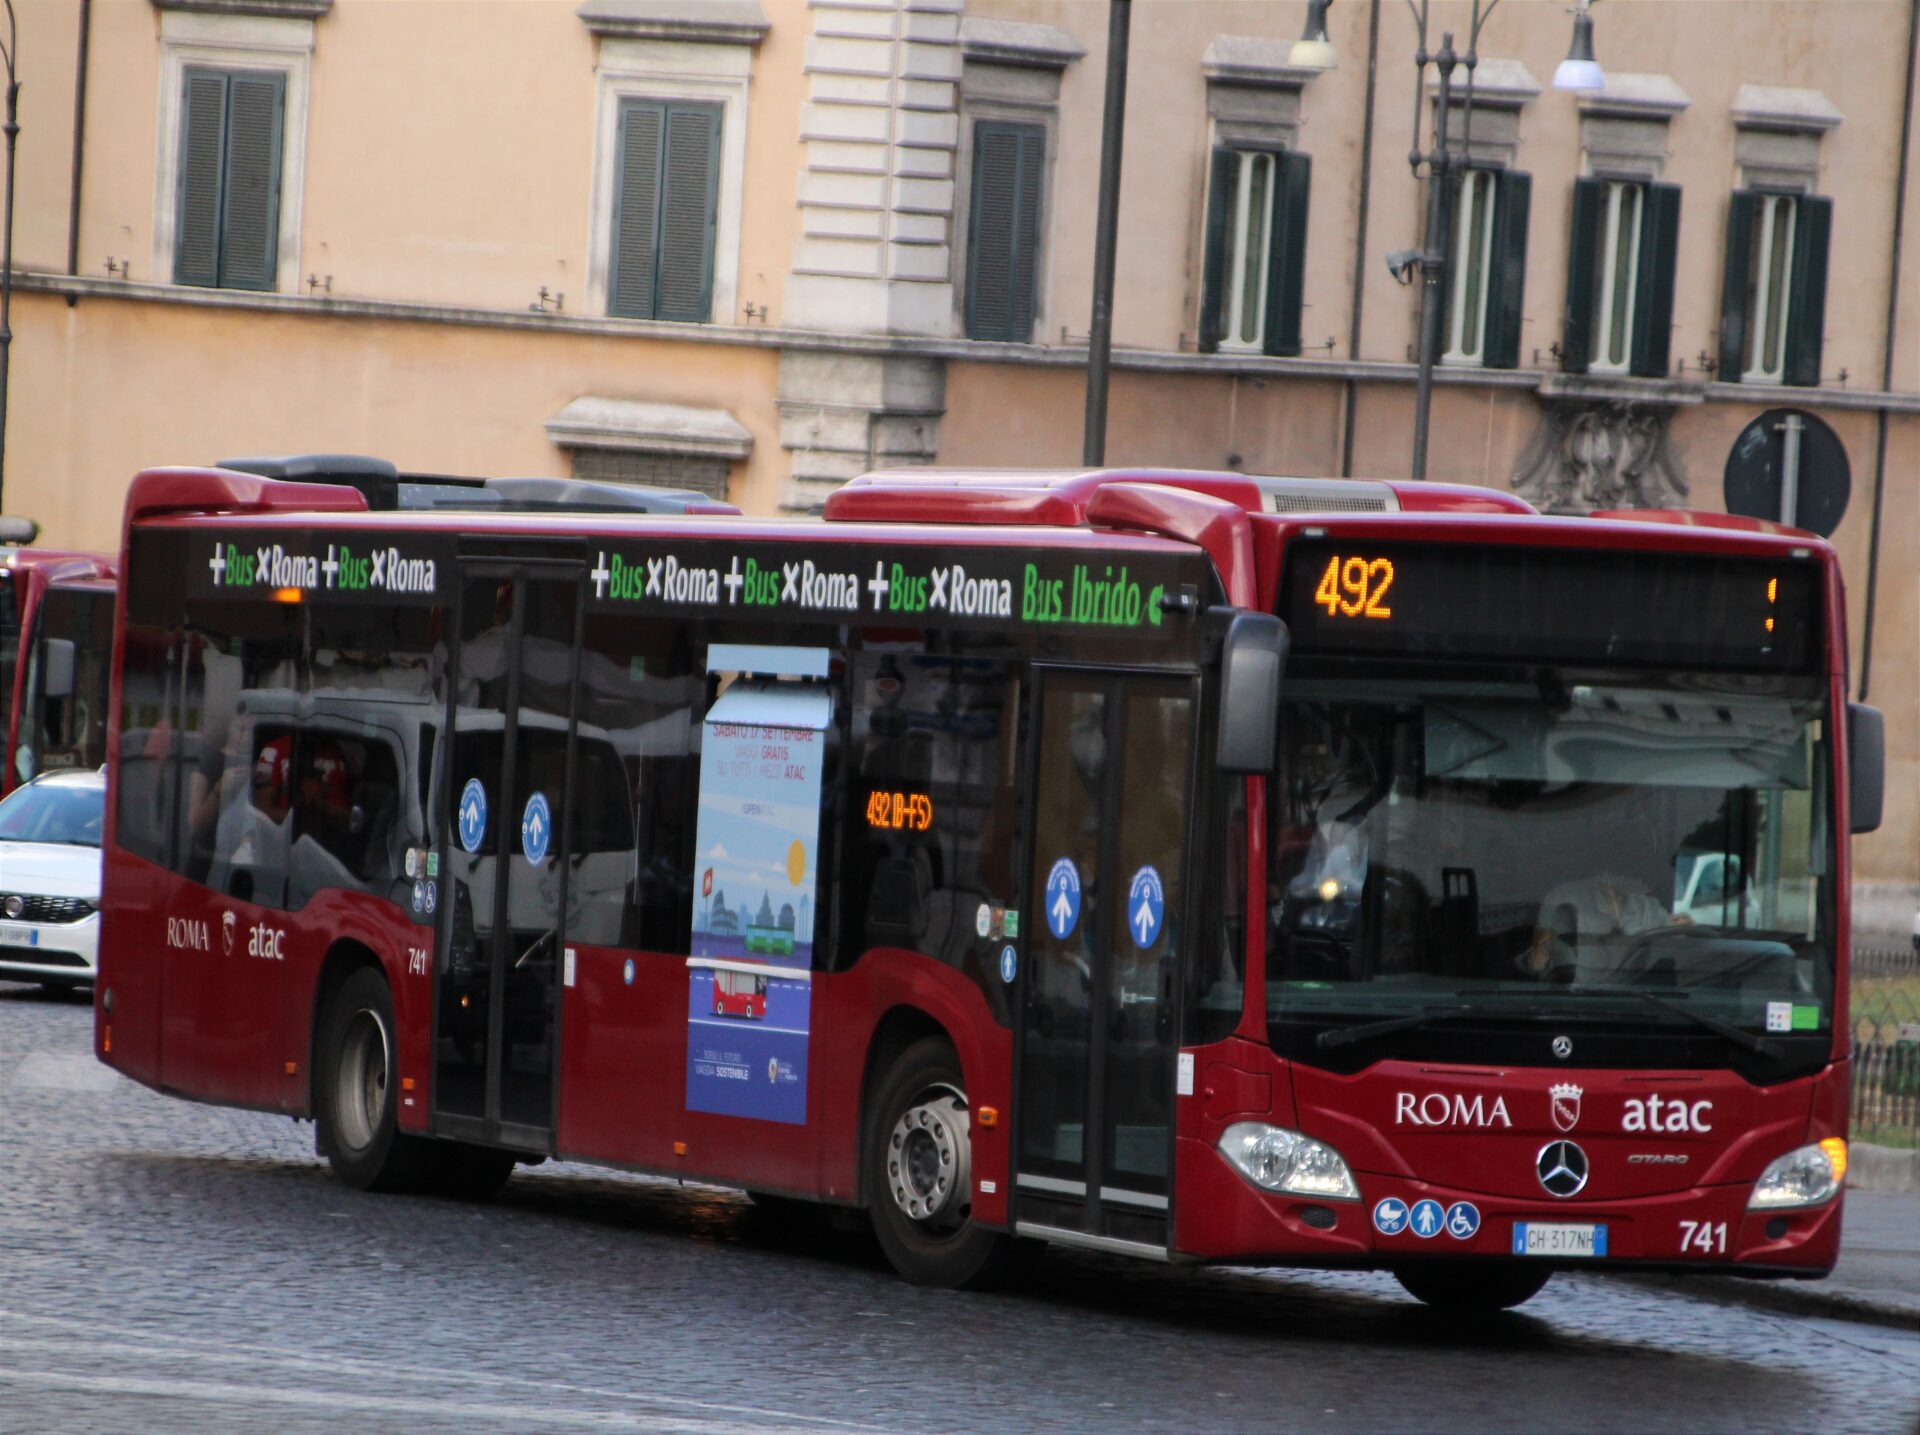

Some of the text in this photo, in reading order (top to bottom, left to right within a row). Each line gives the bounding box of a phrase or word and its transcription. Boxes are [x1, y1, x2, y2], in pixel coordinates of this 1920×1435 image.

[1022, 563, 1141, 625] Bus Ibrido
[1315, 556, 1393, 618] 492
[761, 745, 789, 761] GRATIS
[784, 765, 805, 781] ATAC
[866, 791, 890, 826] 492
[167, 917, 209, 951] ROMA
[248, 922, 285, 960] atac
[408, 947, 426, 976] 741
[1395, 1091, 1513, 1127] ROMA
[1622, 1093, 1713, 1132] atac
[1627, 1154, 1689, 1165] CITARO
[1679, 1221, 1727, 1254] 741
